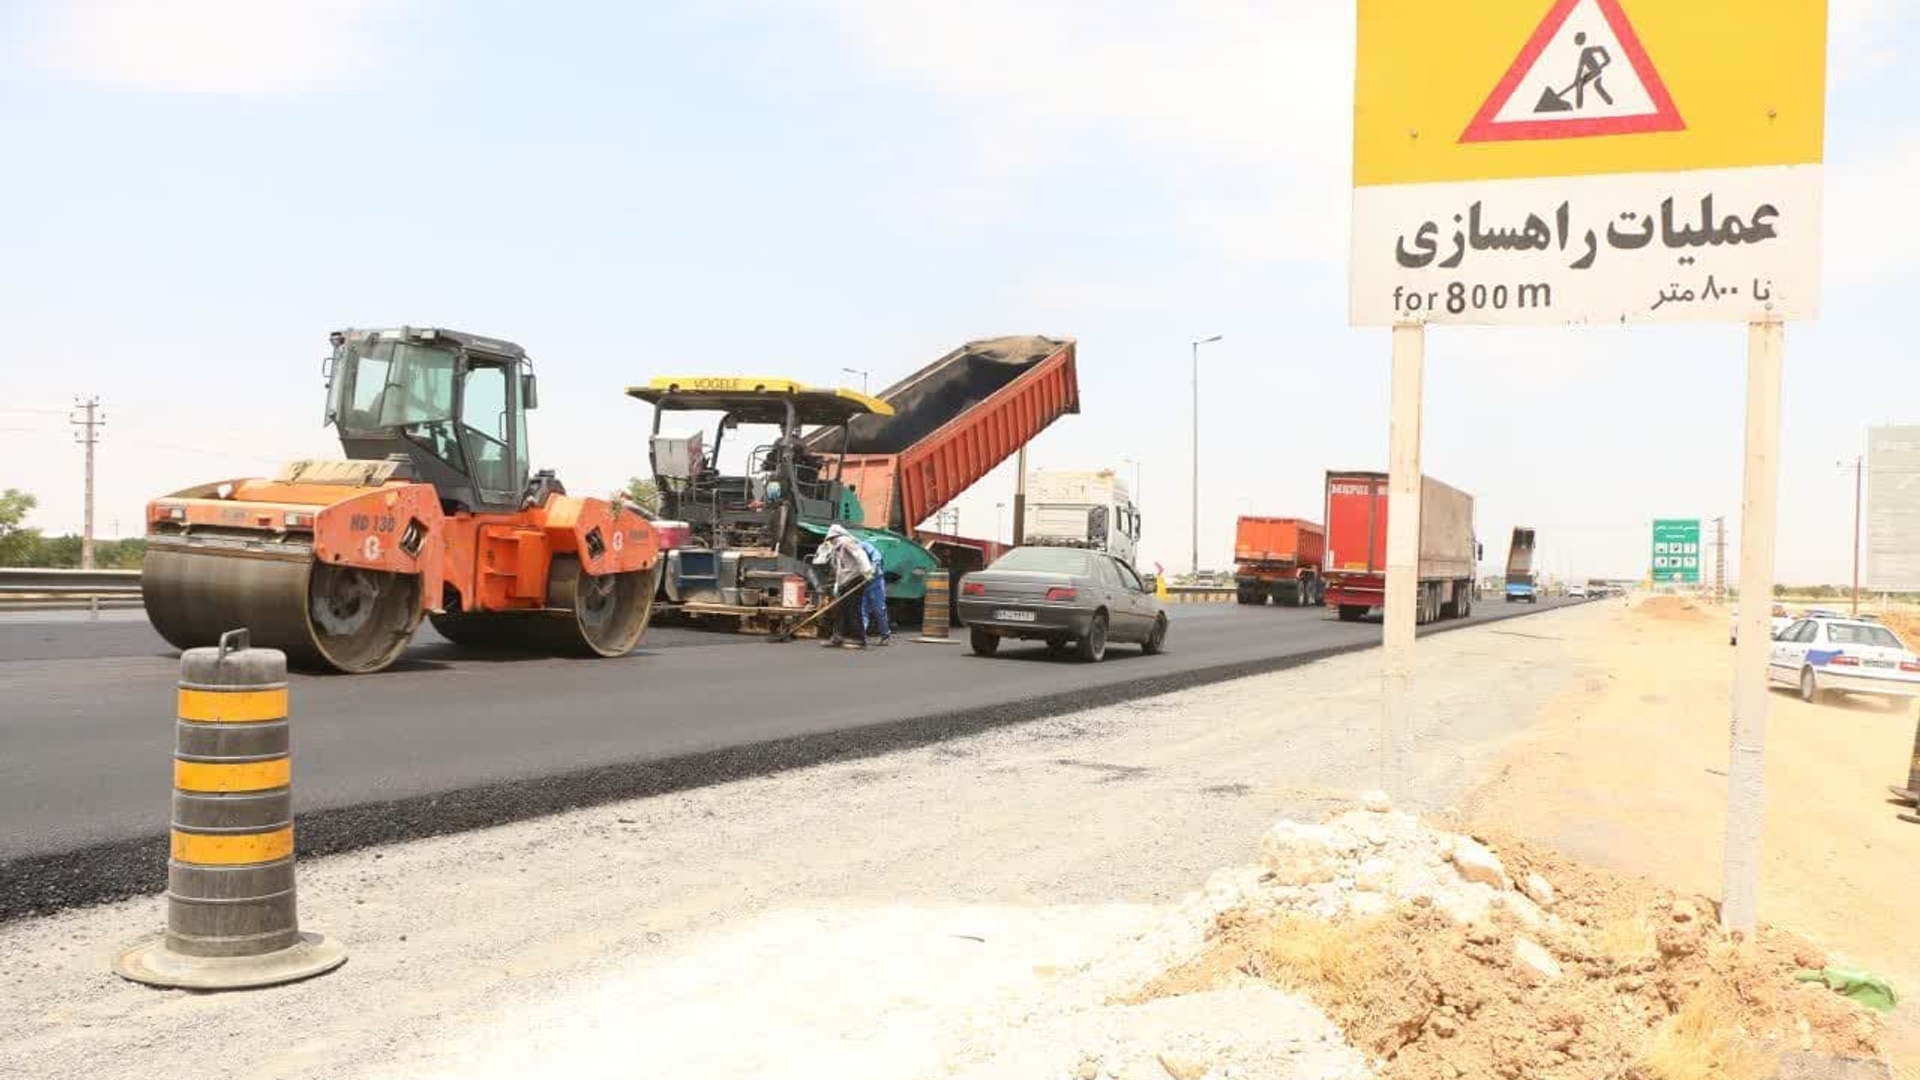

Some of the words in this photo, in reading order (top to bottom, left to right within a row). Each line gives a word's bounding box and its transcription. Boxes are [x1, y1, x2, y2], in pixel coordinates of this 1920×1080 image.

[1606, 192, 1780, 267] عملیات
[1392, 285, 1439, 311] for
[1650, 283, 1695, 311] متر
